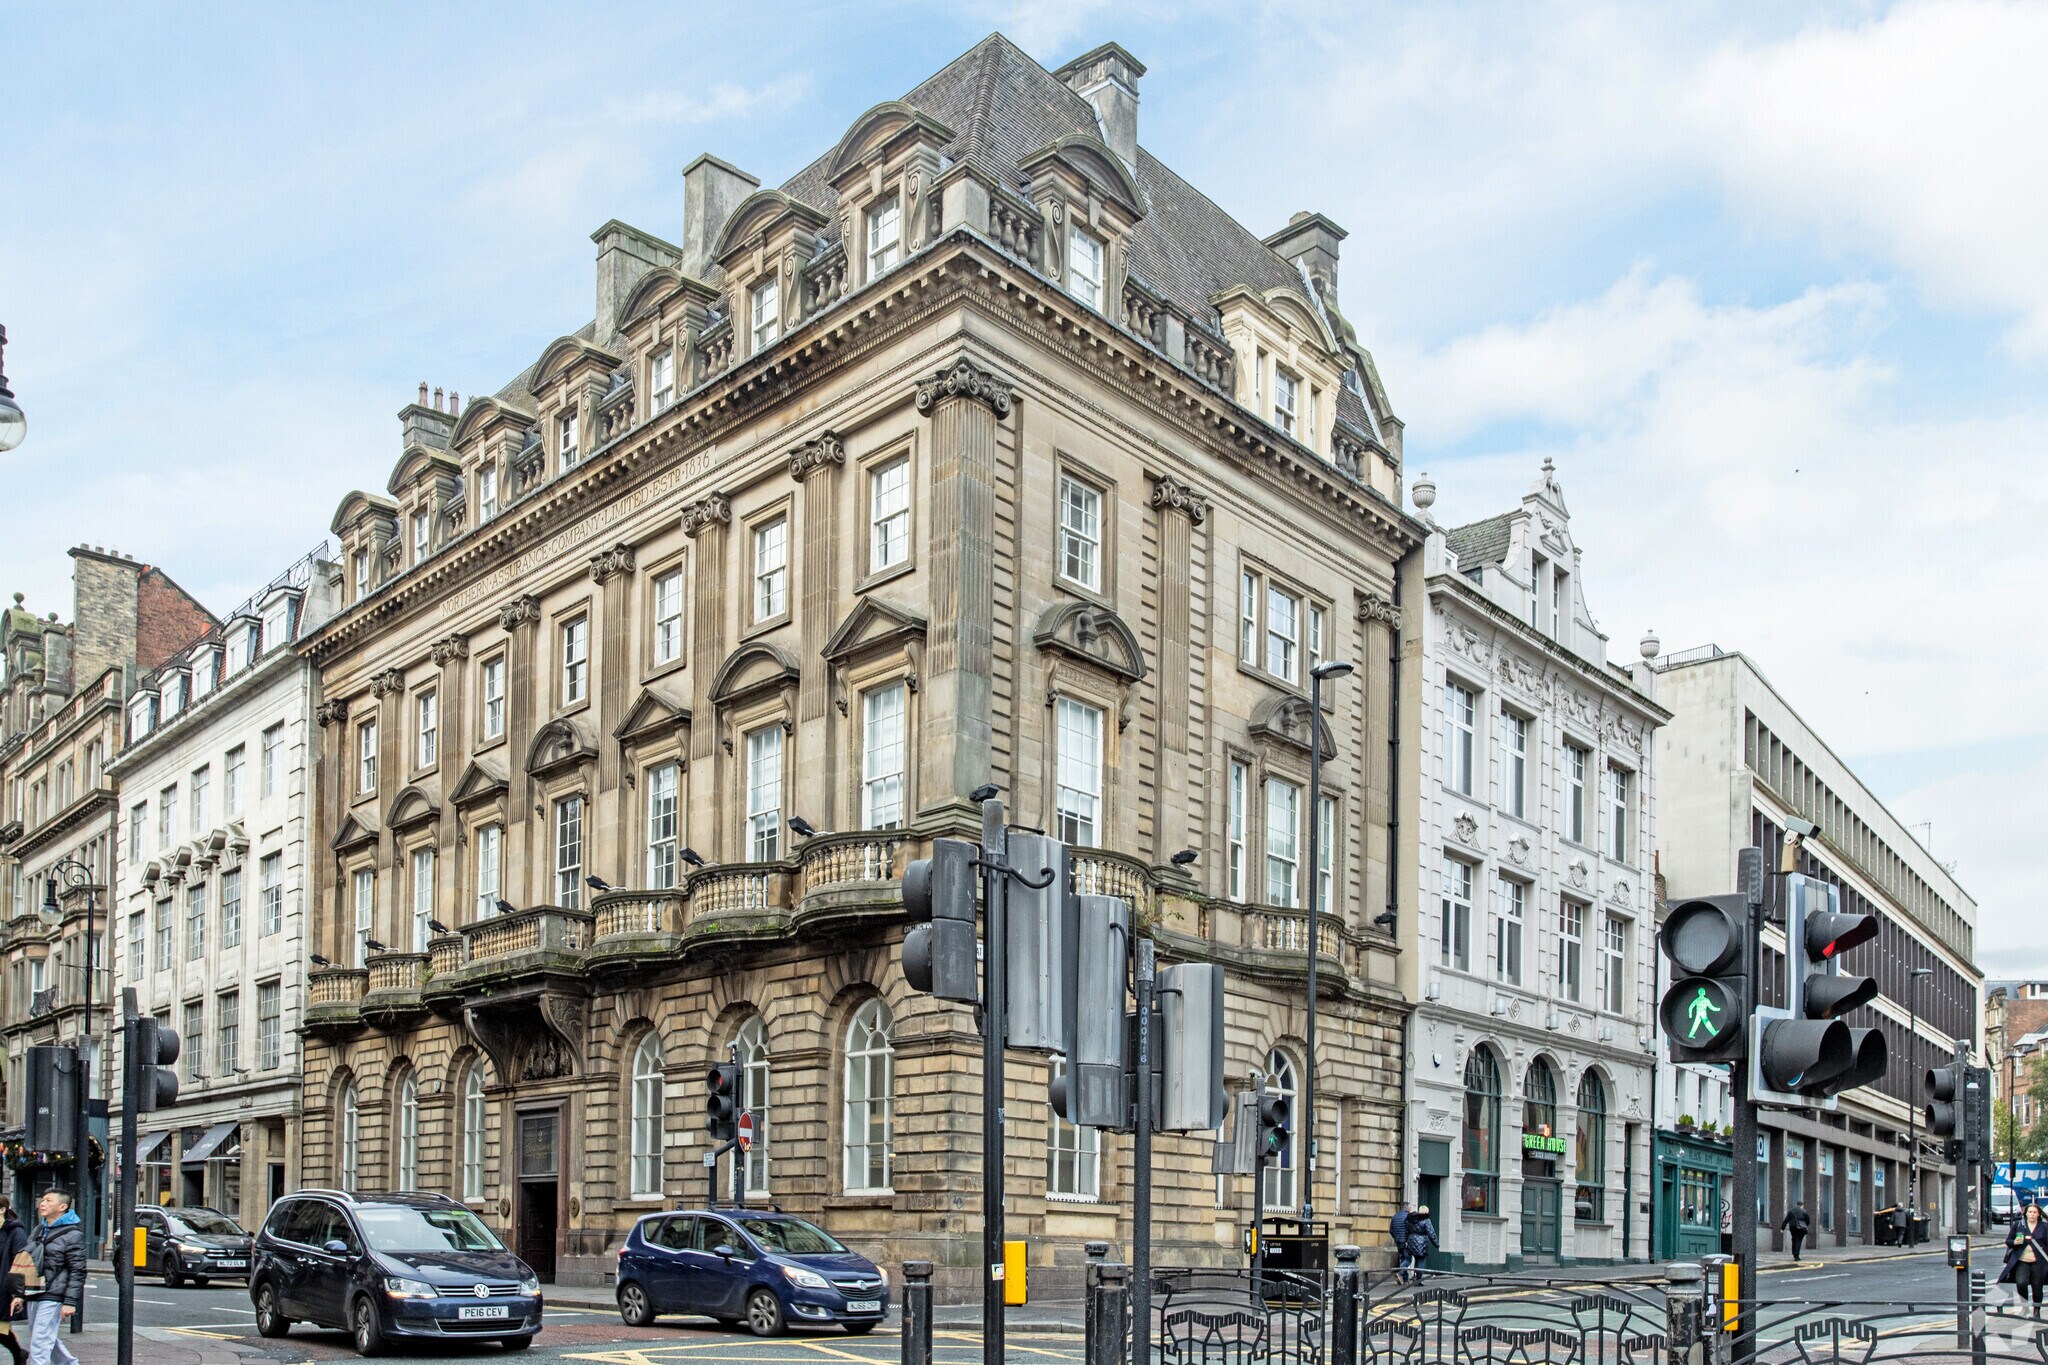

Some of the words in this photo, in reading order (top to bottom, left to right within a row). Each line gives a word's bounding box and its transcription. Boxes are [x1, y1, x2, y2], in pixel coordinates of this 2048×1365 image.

[491, 544, 548, 589] ASSURANCE
[551, 513, 601, 553] COMPANY
[604, 486, 649, 525] LIMITED
[1524, 1134, 1545, 1150] GREEN
[1547, 1137, 1567, 1153] HOUSE
[464, 1308, 485, 1317] PE16
[486, 1307, 503, 1317] CEV
